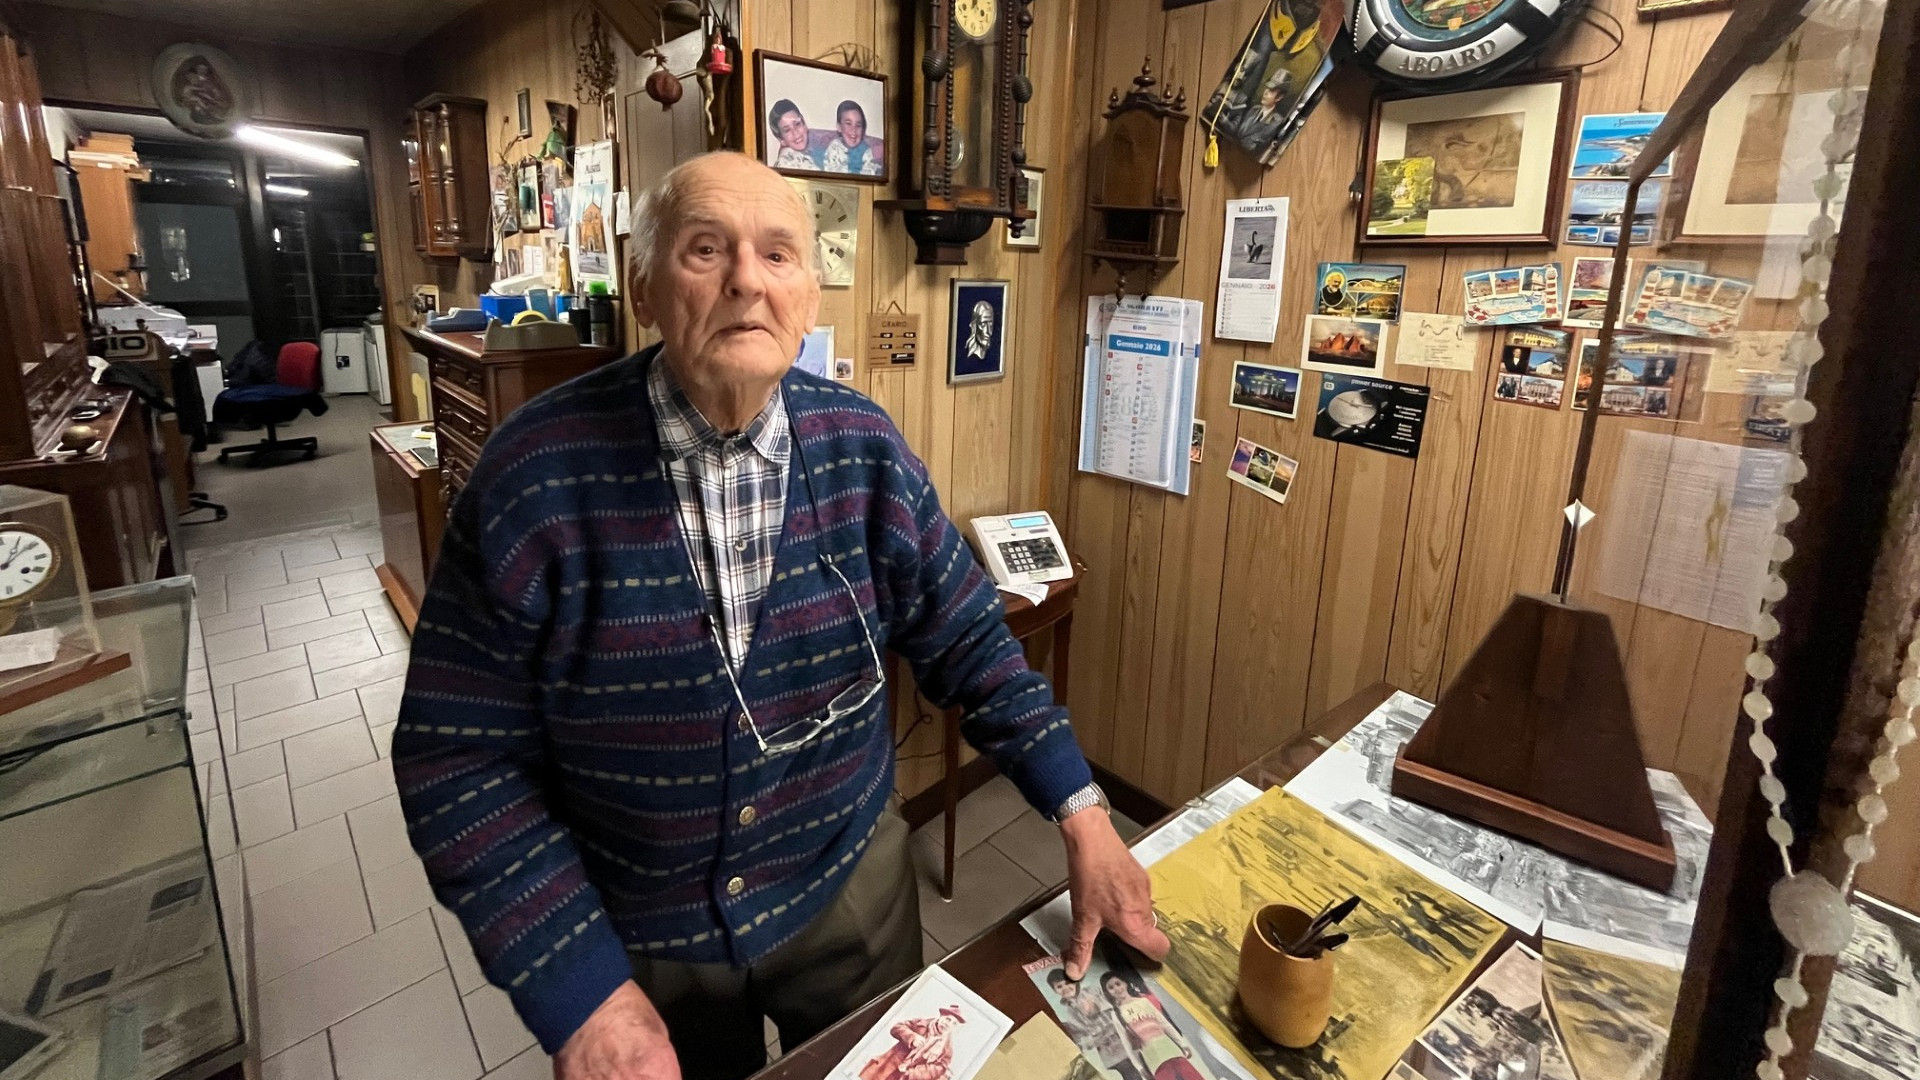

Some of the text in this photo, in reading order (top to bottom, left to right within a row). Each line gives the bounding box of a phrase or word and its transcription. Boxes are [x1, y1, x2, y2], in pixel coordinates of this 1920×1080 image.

[1399, 39, 1497, 74] ABOARD
[1116, 340, 1162, 352] Gennaio 2026
[1371, 380, 1393, 390] source
